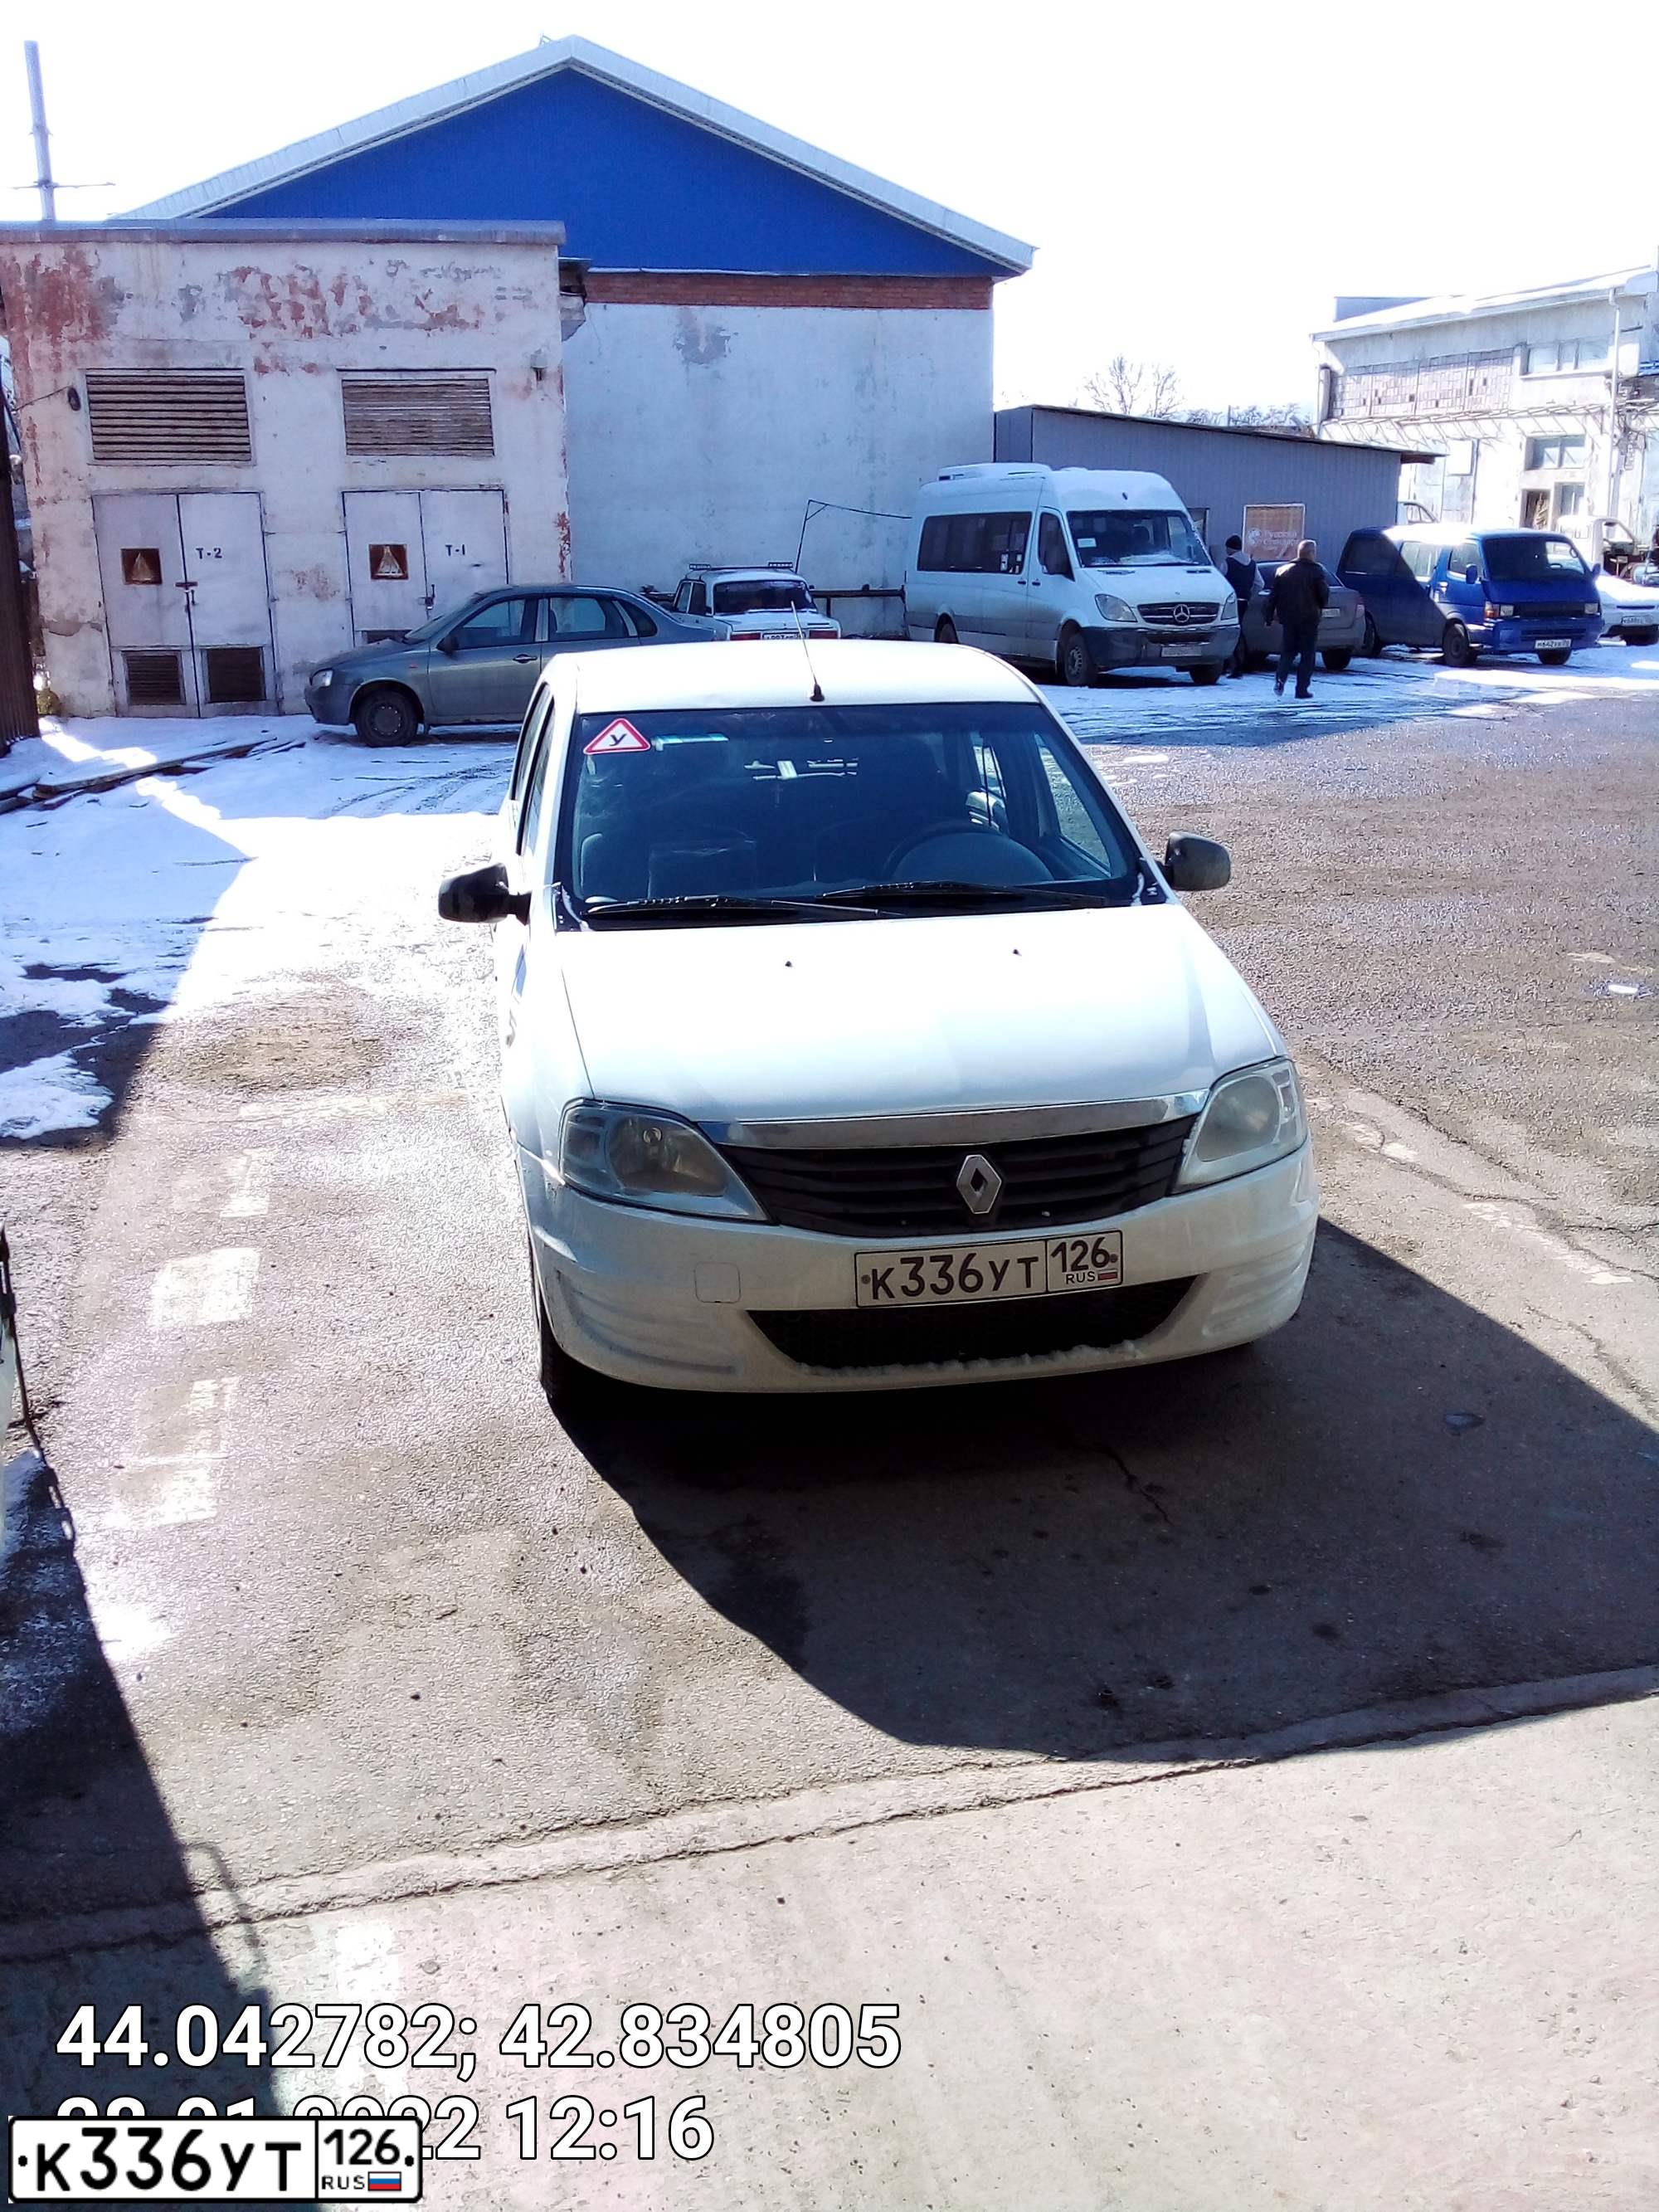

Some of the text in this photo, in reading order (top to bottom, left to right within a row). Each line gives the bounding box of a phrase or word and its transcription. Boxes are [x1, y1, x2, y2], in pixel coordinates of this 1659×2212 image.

[610, 733, 627, 747] У
[871, 1236, 1110, 1300] К336УТ 126
[1065, 1270, 1096, 1285] RUS
